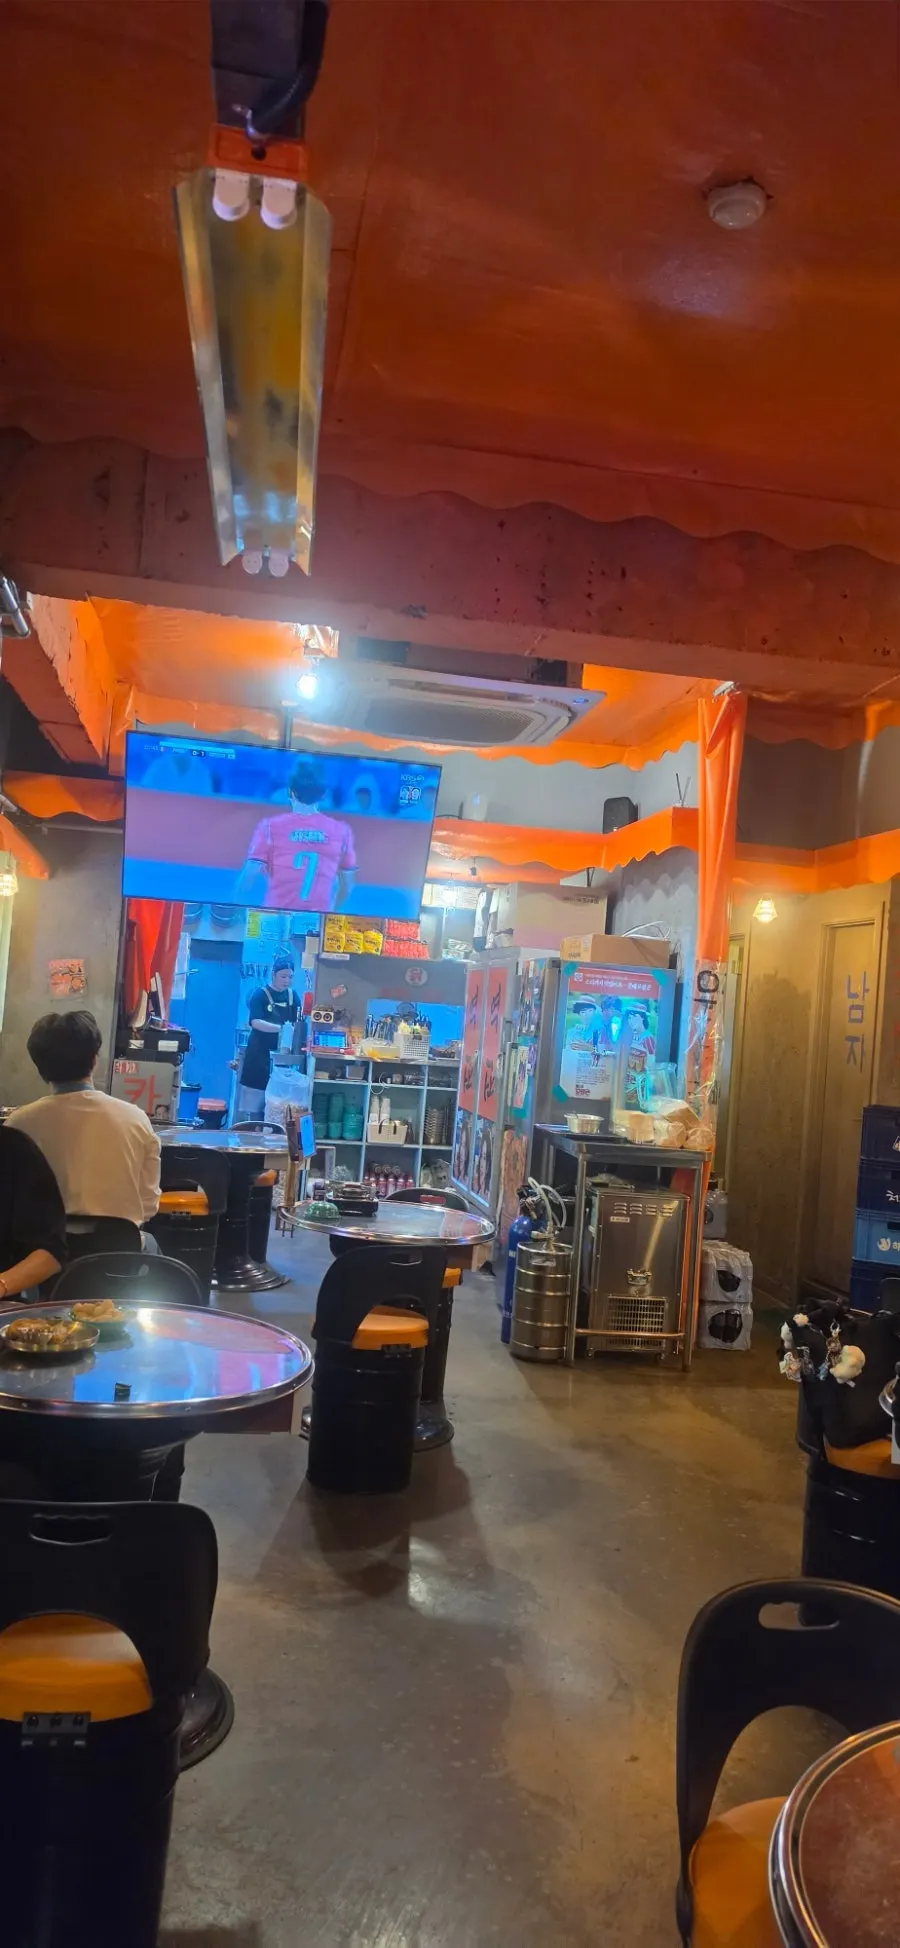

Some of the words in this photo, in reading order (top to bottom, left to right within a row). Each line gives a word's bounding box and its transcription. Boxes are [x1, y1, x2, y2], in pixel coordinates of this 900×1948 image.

[292, 850, 319, 900] 7
[844, 970, 870, 1073] 남자
[122, 1073, 164, 1114] 카
